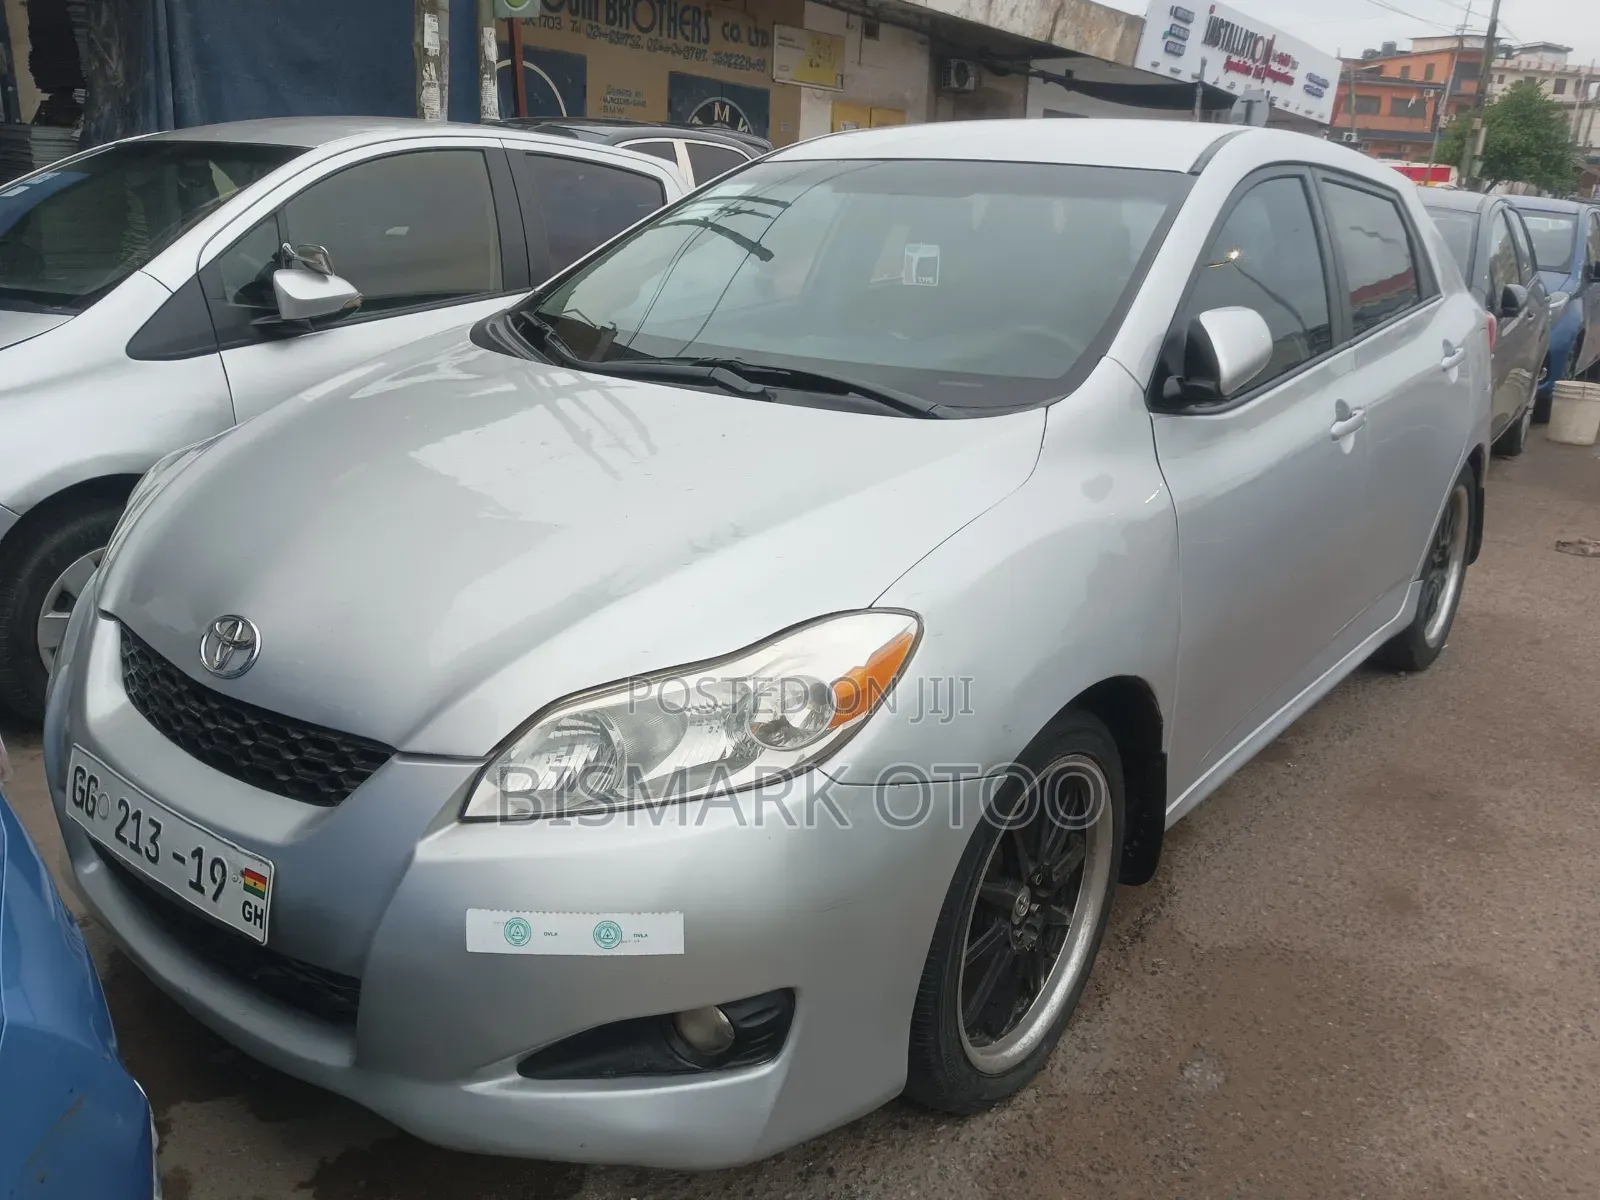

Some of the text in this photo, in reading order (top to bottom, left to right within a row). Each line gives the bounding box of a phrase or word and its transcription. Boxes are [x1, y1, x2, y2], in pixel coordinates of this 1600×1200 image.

[72, 765, 99, 819] GG
[114, 796, 163, 865] 213
[241, 900, 264, 930] GH
